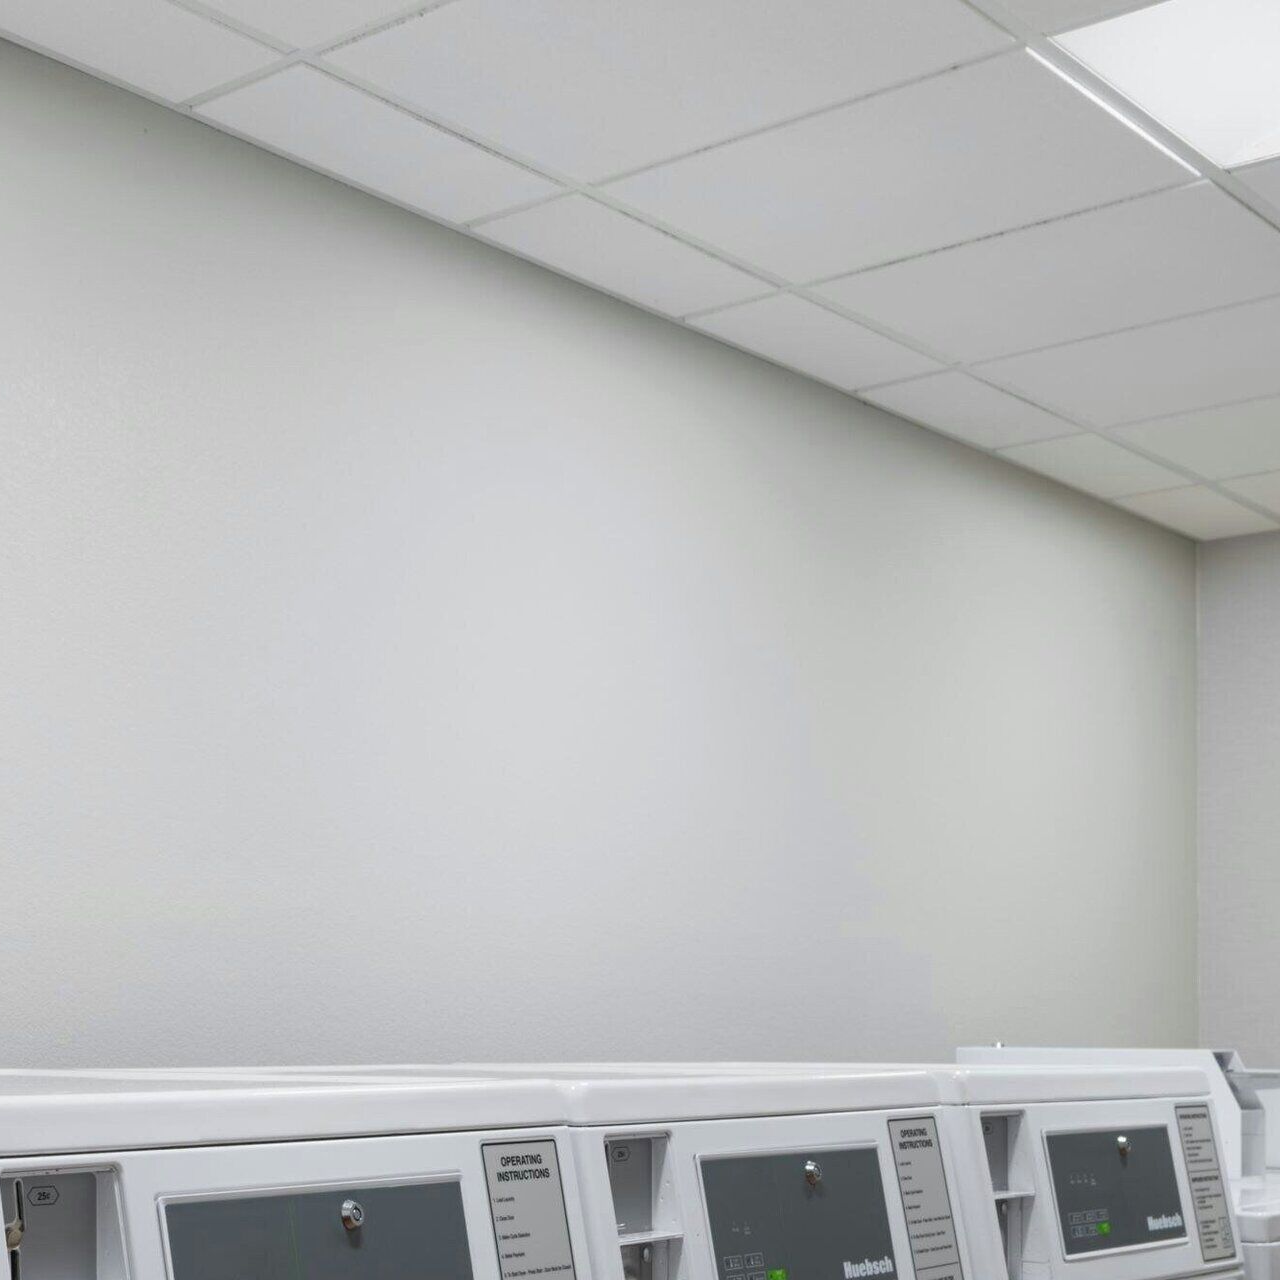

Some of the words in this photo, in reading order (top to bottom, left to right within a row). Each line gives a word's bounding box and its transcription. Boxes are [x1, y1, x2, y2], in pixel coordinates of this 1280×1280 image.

[900, 1128, 928, 1139] OPERATING
[500, 1154, 542, 1167] OPERATING
[497, 1168, 550, 1182] INSTRUCTIONS
[843, 1256, 894, 1280] Huebsch
